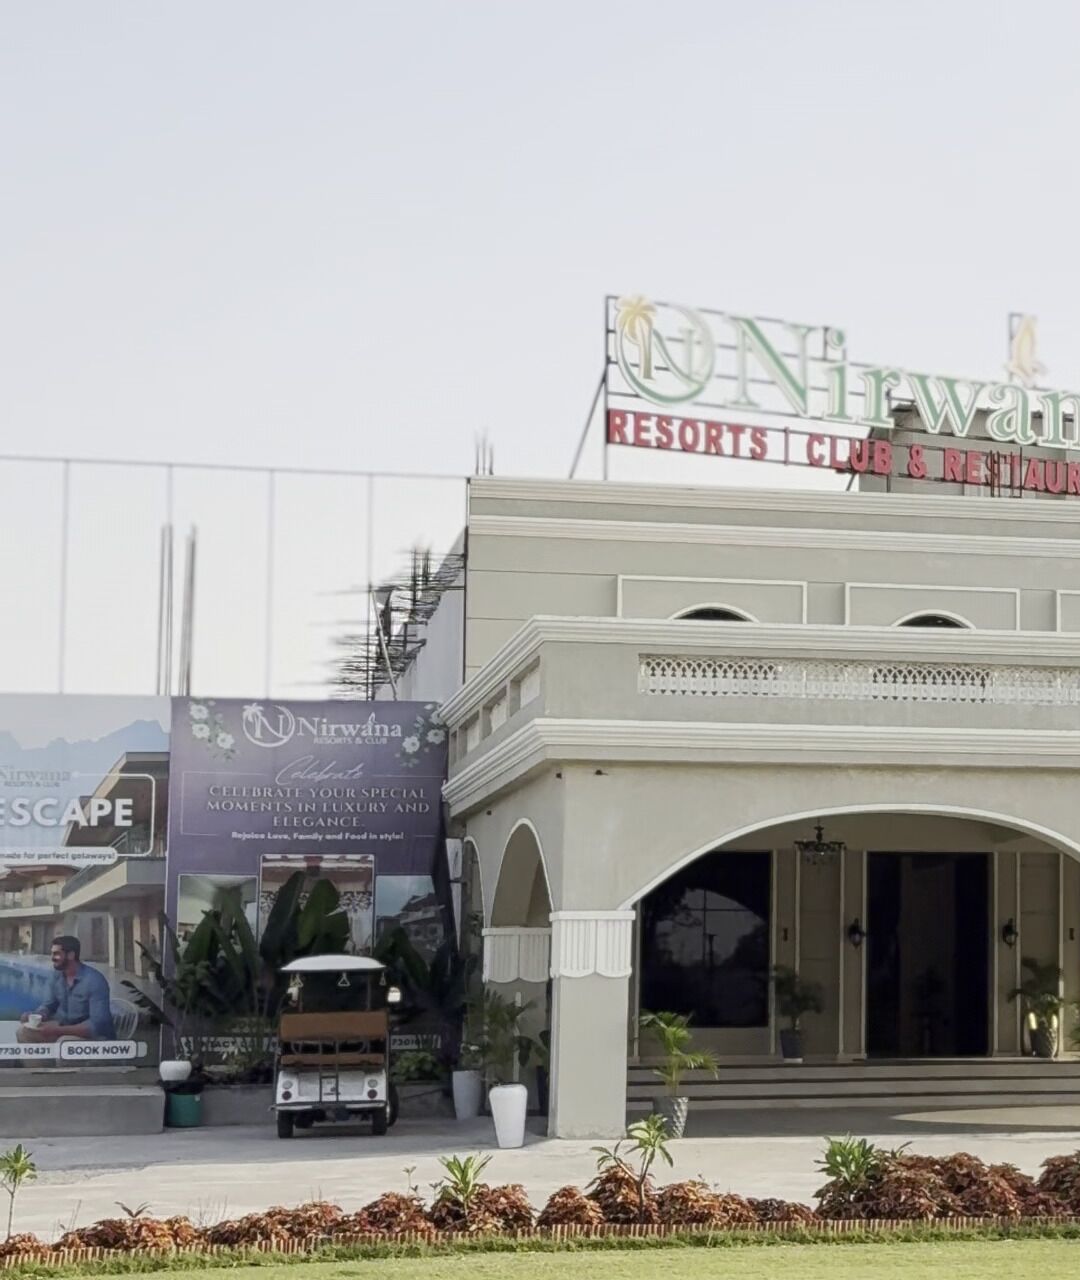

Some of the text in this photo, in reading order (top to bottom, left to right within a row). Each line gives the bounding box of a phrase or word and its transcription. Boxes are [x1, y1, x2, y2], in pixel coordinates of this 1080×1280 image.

[607, 408, 769, 461] RESORTS
[806, 435, 893, 475] CLUB
[907, 443, 928, 479] &
[296, 716, 402, 738] Nirwana
[209, 786, 427, 800] CELEBRATE YOUR SPECIAL
[207, 801, 431, 814] MOMENTS IN LUXURY AND
[67, 1046, 100, 1056] BOOK
[102, 1045, 131, 1055] NOW
